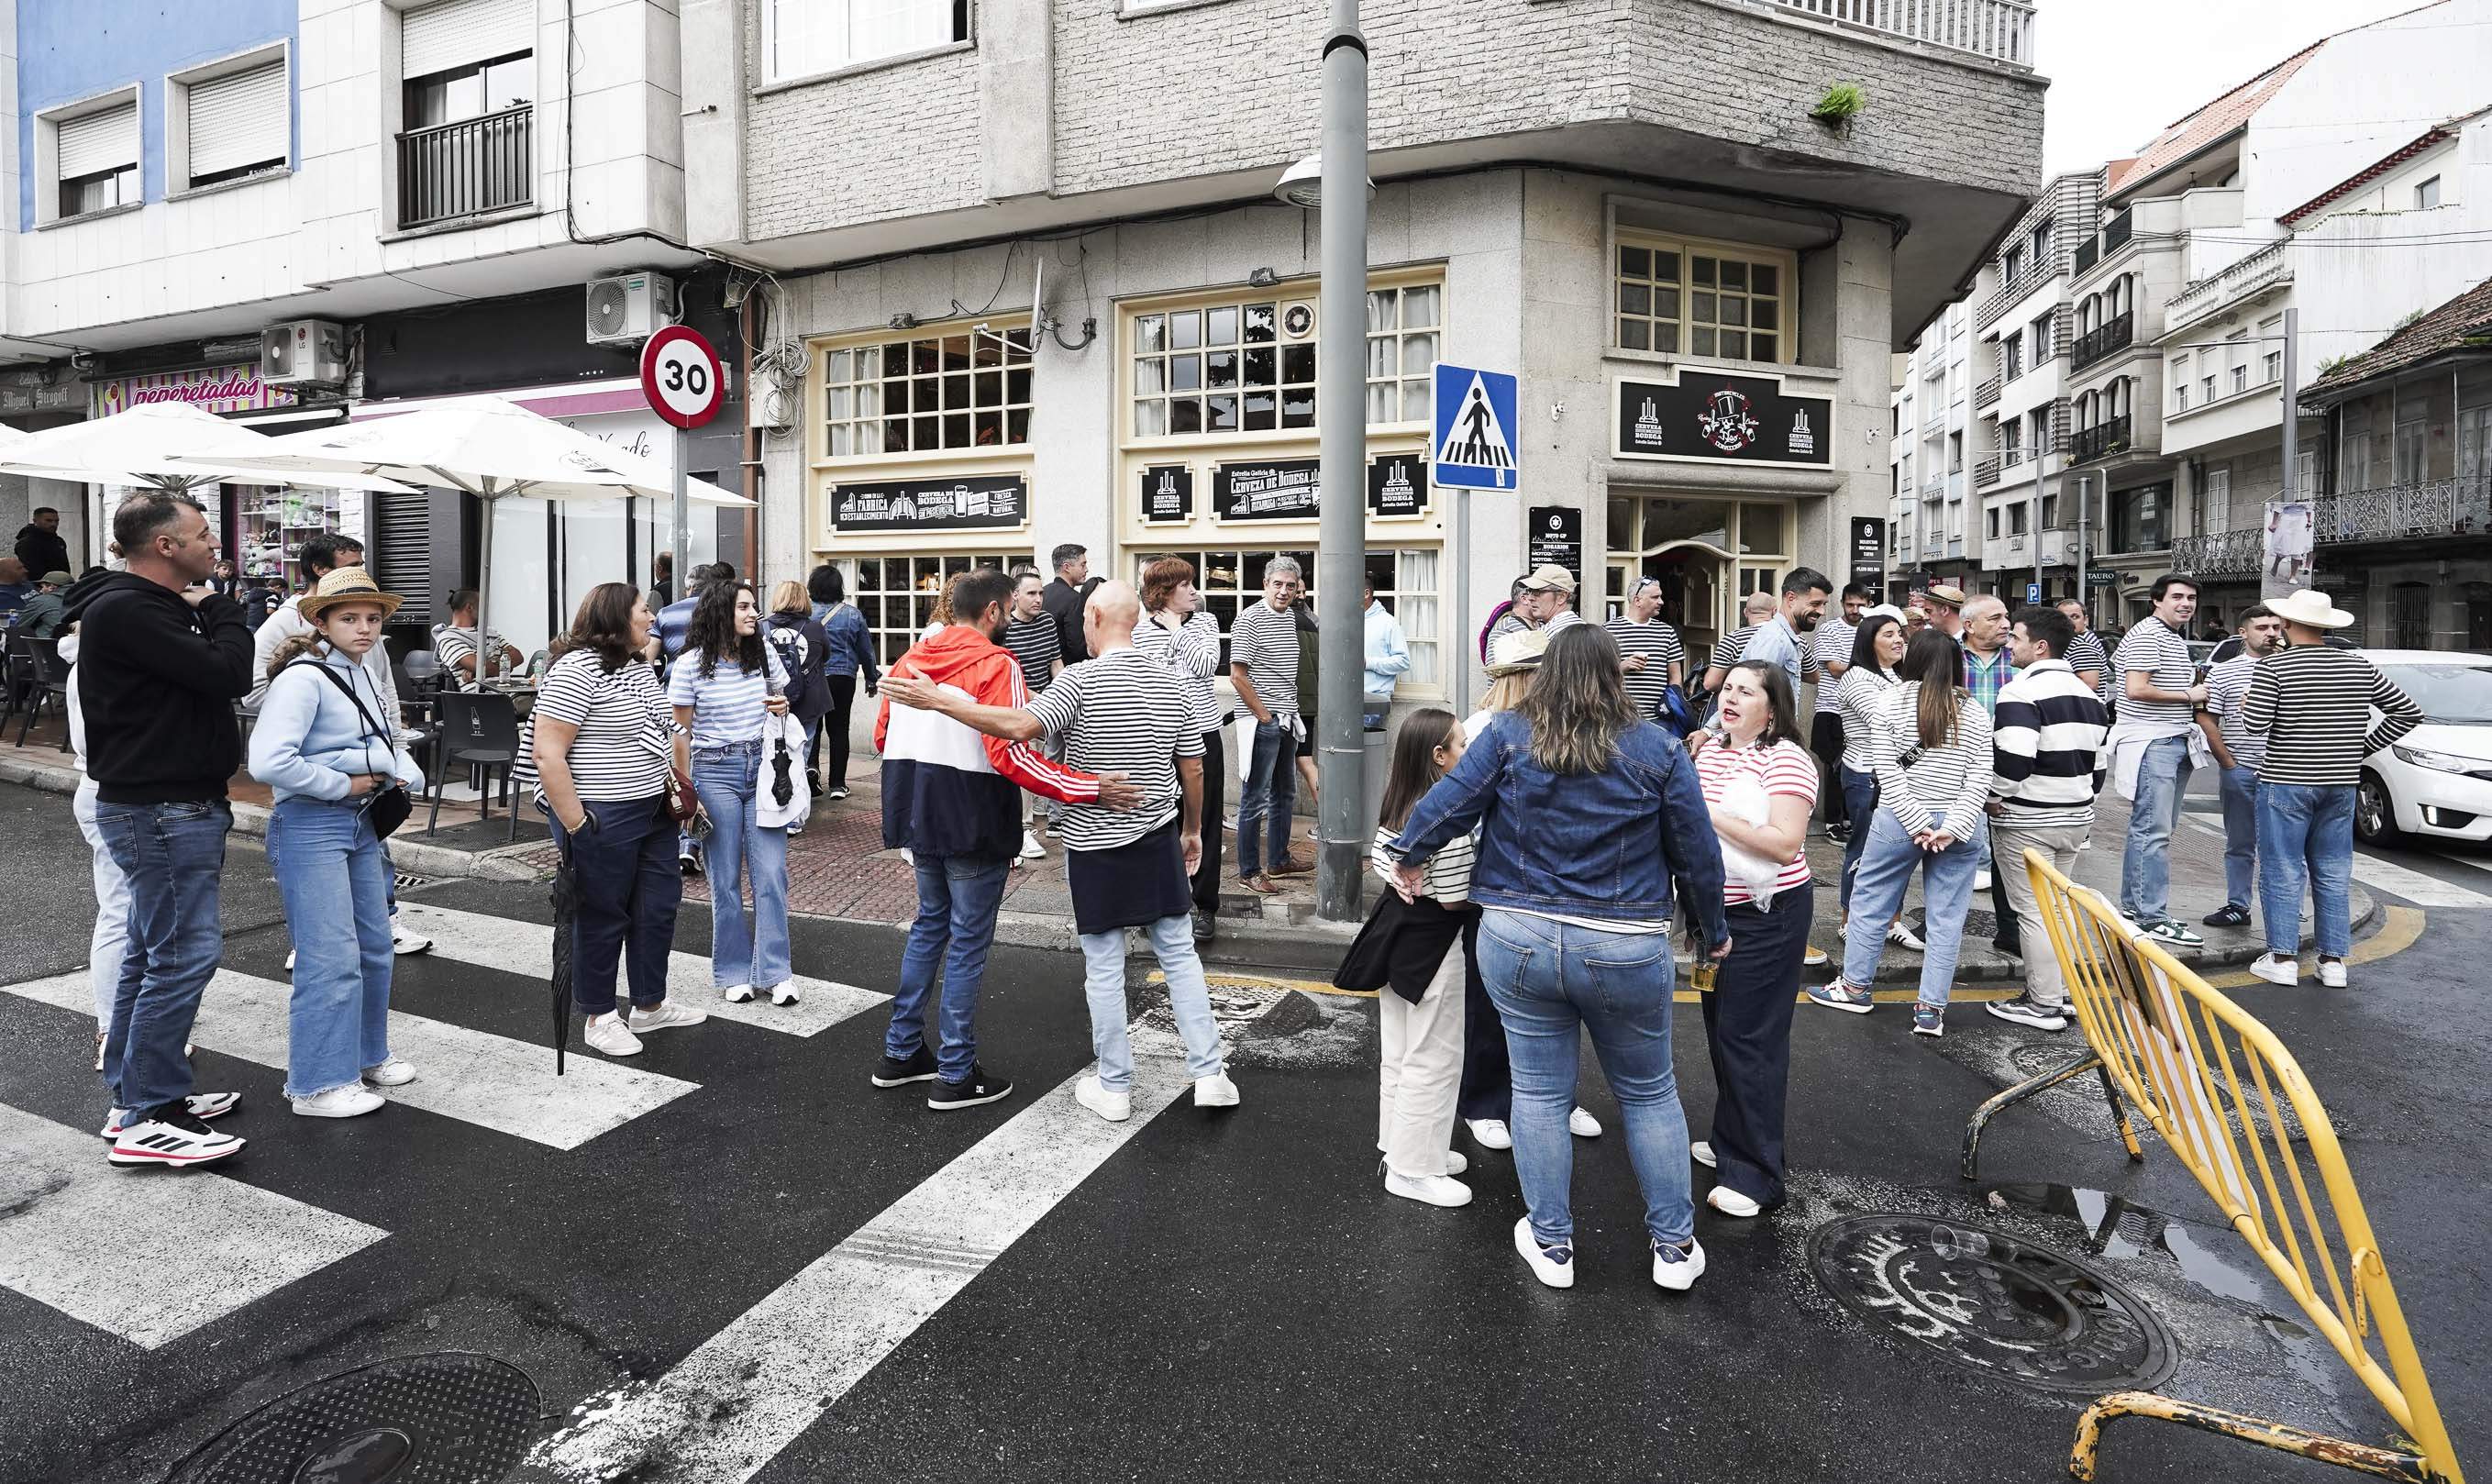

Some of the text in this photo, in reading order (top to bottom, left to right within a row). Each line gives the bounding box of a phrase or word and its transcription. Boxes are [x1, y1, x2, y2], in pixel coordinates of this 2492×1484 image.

[665, 360, 706, 394] 30
[135, 371, 260, 404] peperetadas
[3, 387, 68, 410] Miguel Strogoff
[1267, 477, 1278, 489] DE
[917, 496, 954, 504] BODEGA
[994, 492, 1012, 500] FRESCA
[993, 505, 1013, 514] NATURAL
